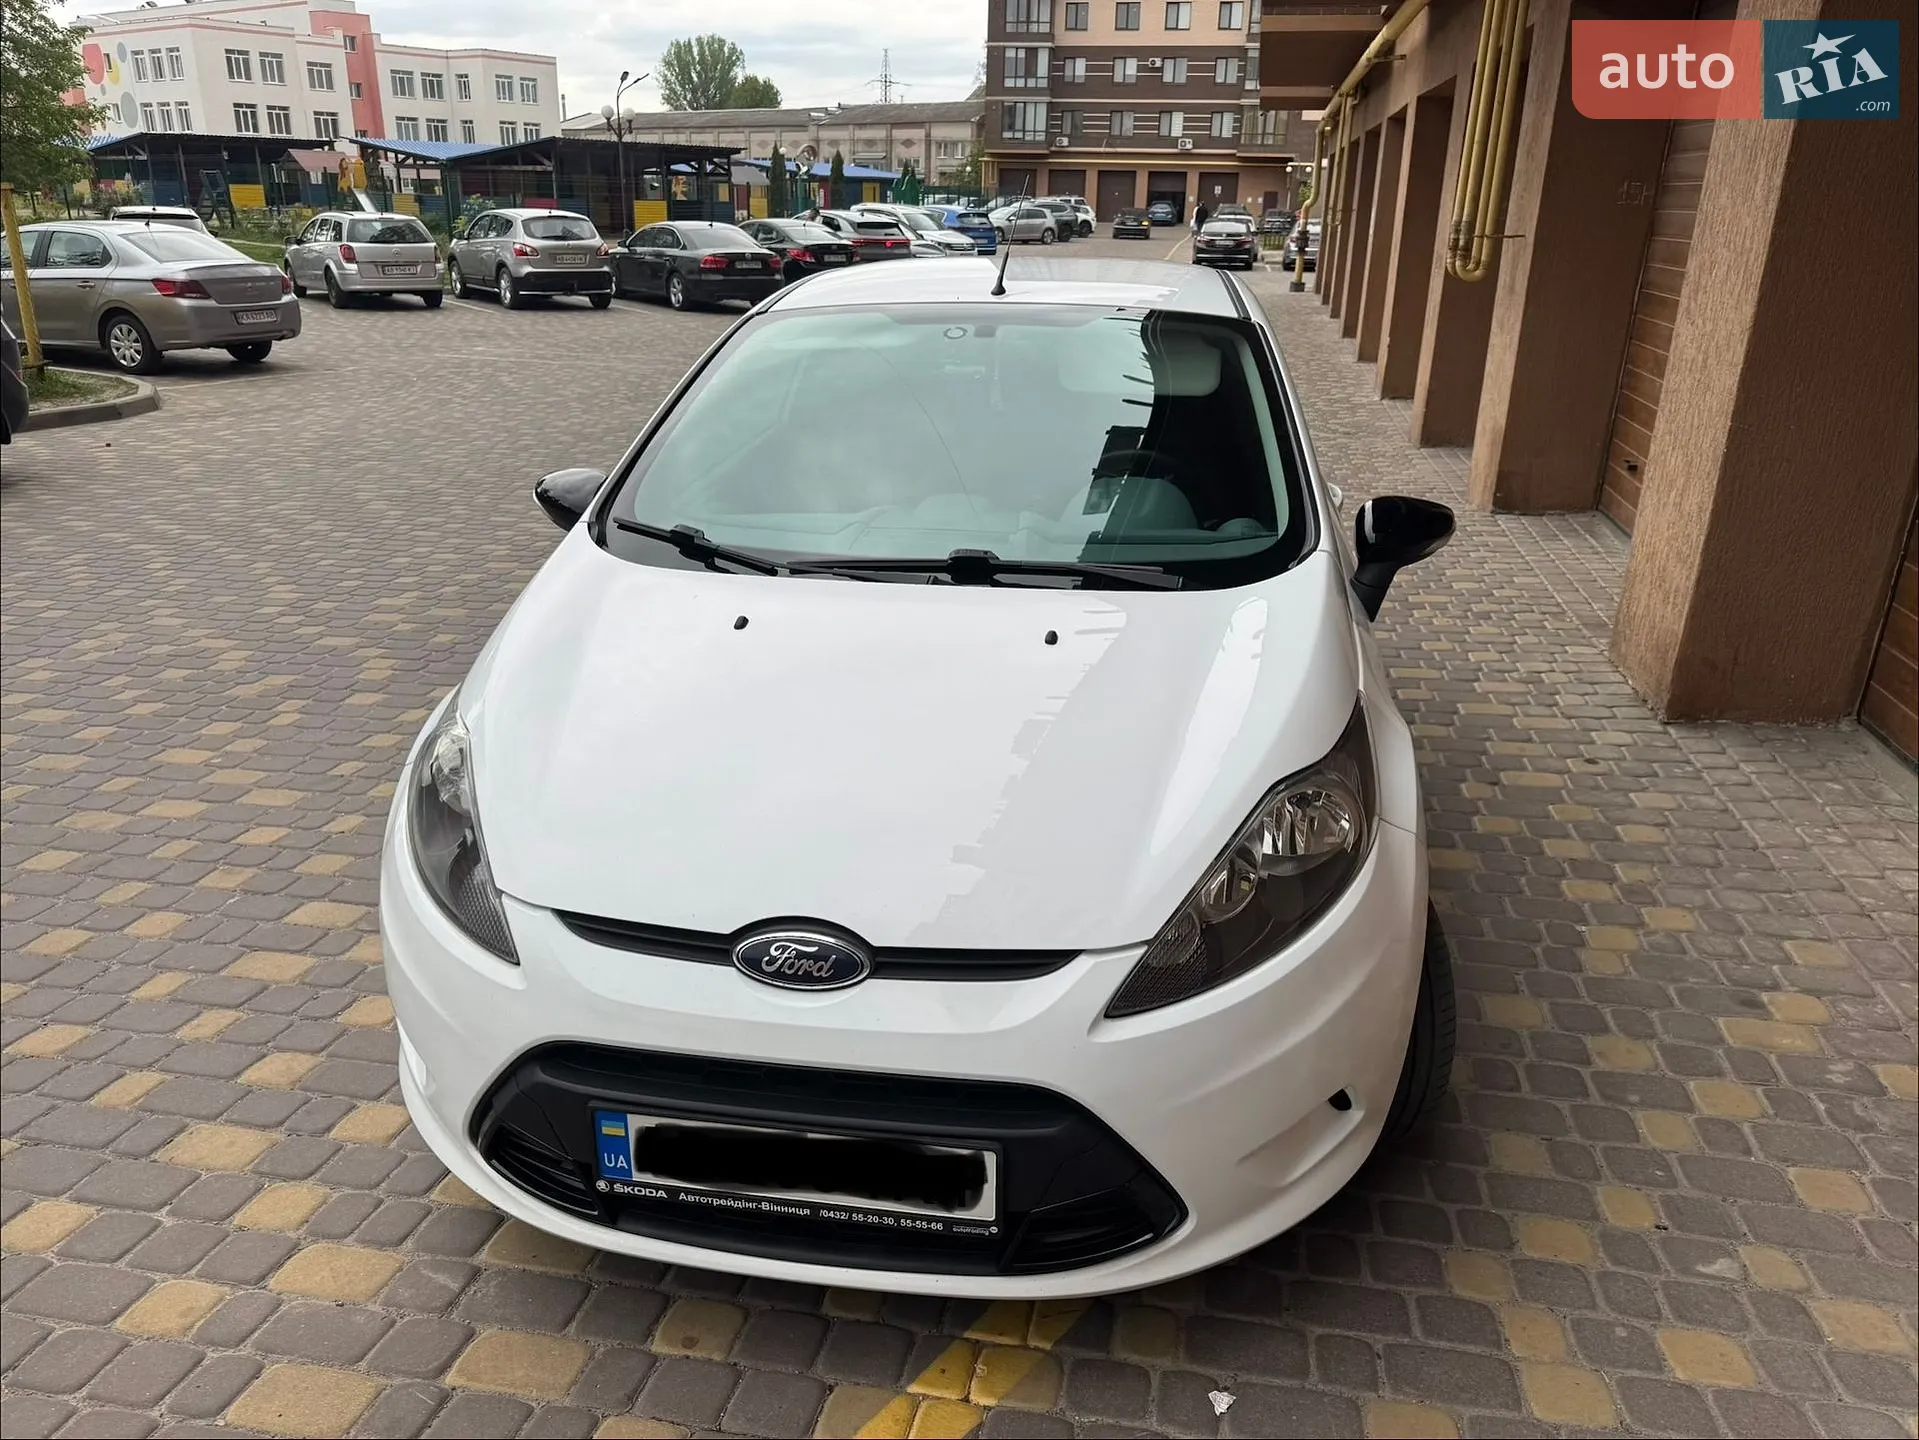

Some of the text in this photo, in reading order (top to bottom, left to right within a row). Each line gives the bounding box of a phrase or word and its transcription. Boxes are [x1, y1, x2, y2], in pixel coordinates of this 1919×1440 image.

[761, 941, 837, 978] Ford
[604, 1152, 629, 1170] UA
[613, 1182, 944, 1231] ŠKODA Автотрейдінг-Вінниця /0432/ 55-20-30, 55-55-66
